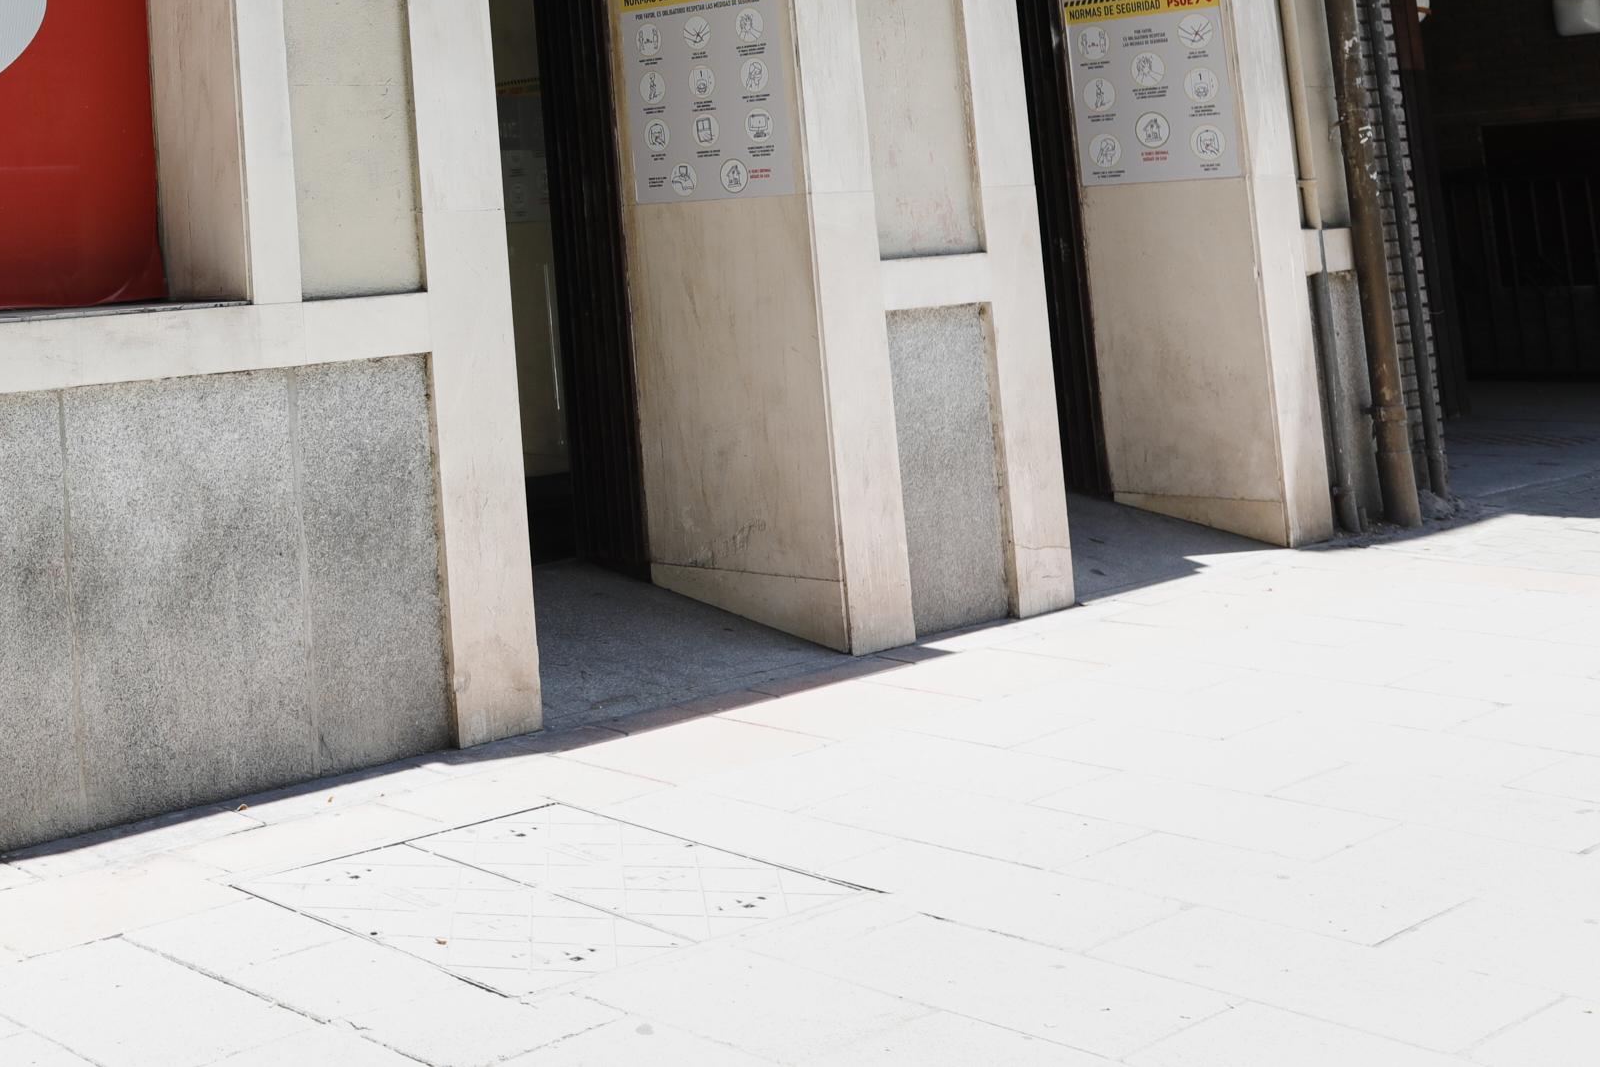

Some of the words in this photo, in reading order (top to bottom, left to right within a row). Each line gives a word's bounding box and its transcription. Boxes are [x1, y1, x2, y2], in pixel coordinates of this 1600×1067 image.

[1069, 4, 1102, 20] NORMAS
[1104, 2, 1114, 15] DE
[1116, 0, 1161, 14] SEGURIDAD
